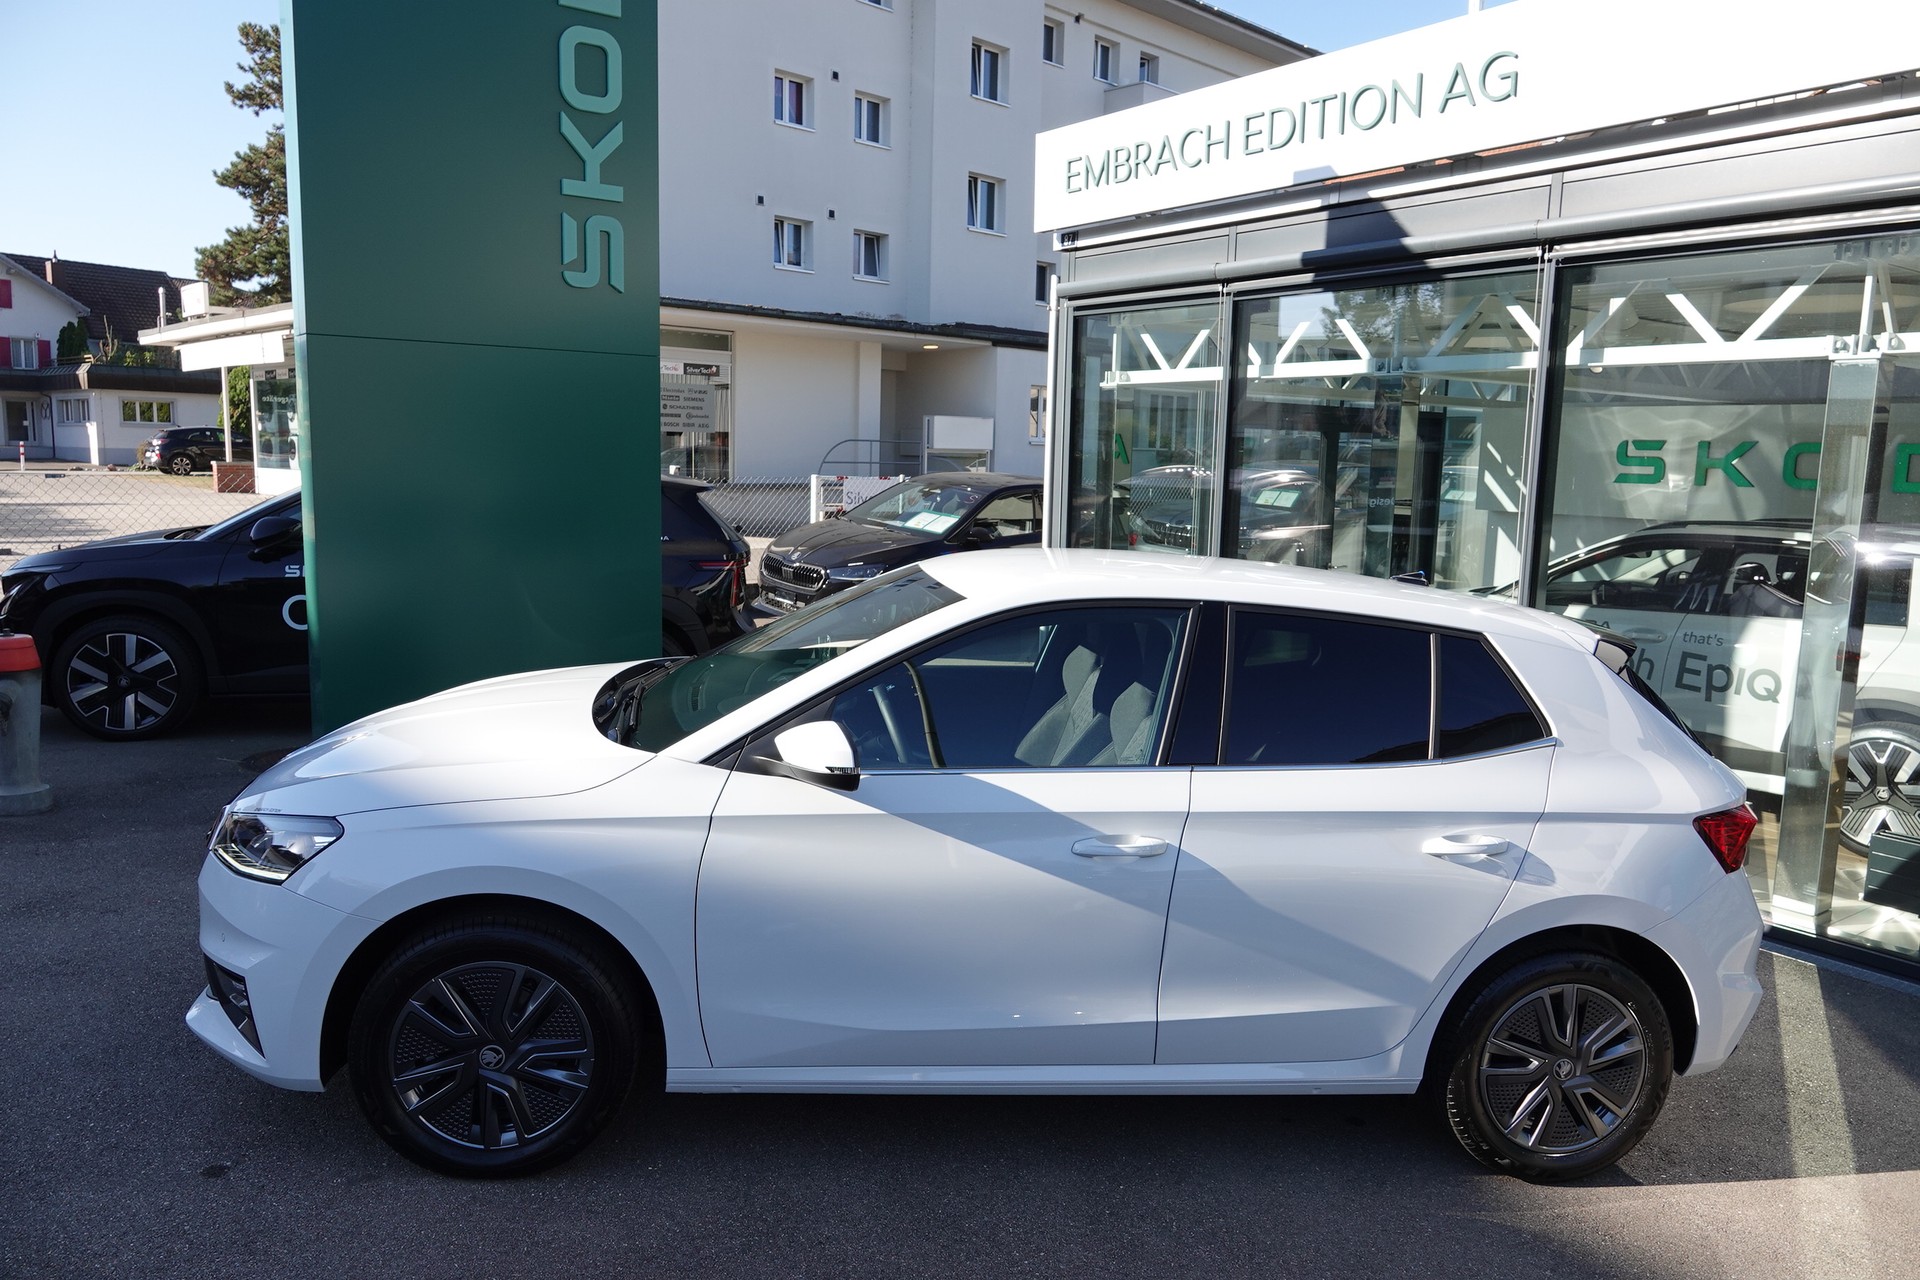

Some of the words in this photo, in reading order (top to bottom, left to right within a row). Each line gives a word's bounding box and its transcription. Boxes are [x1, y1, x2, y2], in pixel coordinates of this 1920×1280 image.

[558, 0, 625, 294] SKO
[1064, 119, 1230, 194] EMBRACH
[1242, 72, 1424, 157] EDITION
[1437, 50, 1520, 115] AG
[284, 564, 305, 578] S
[1682, 631, 1725, 647] that's
